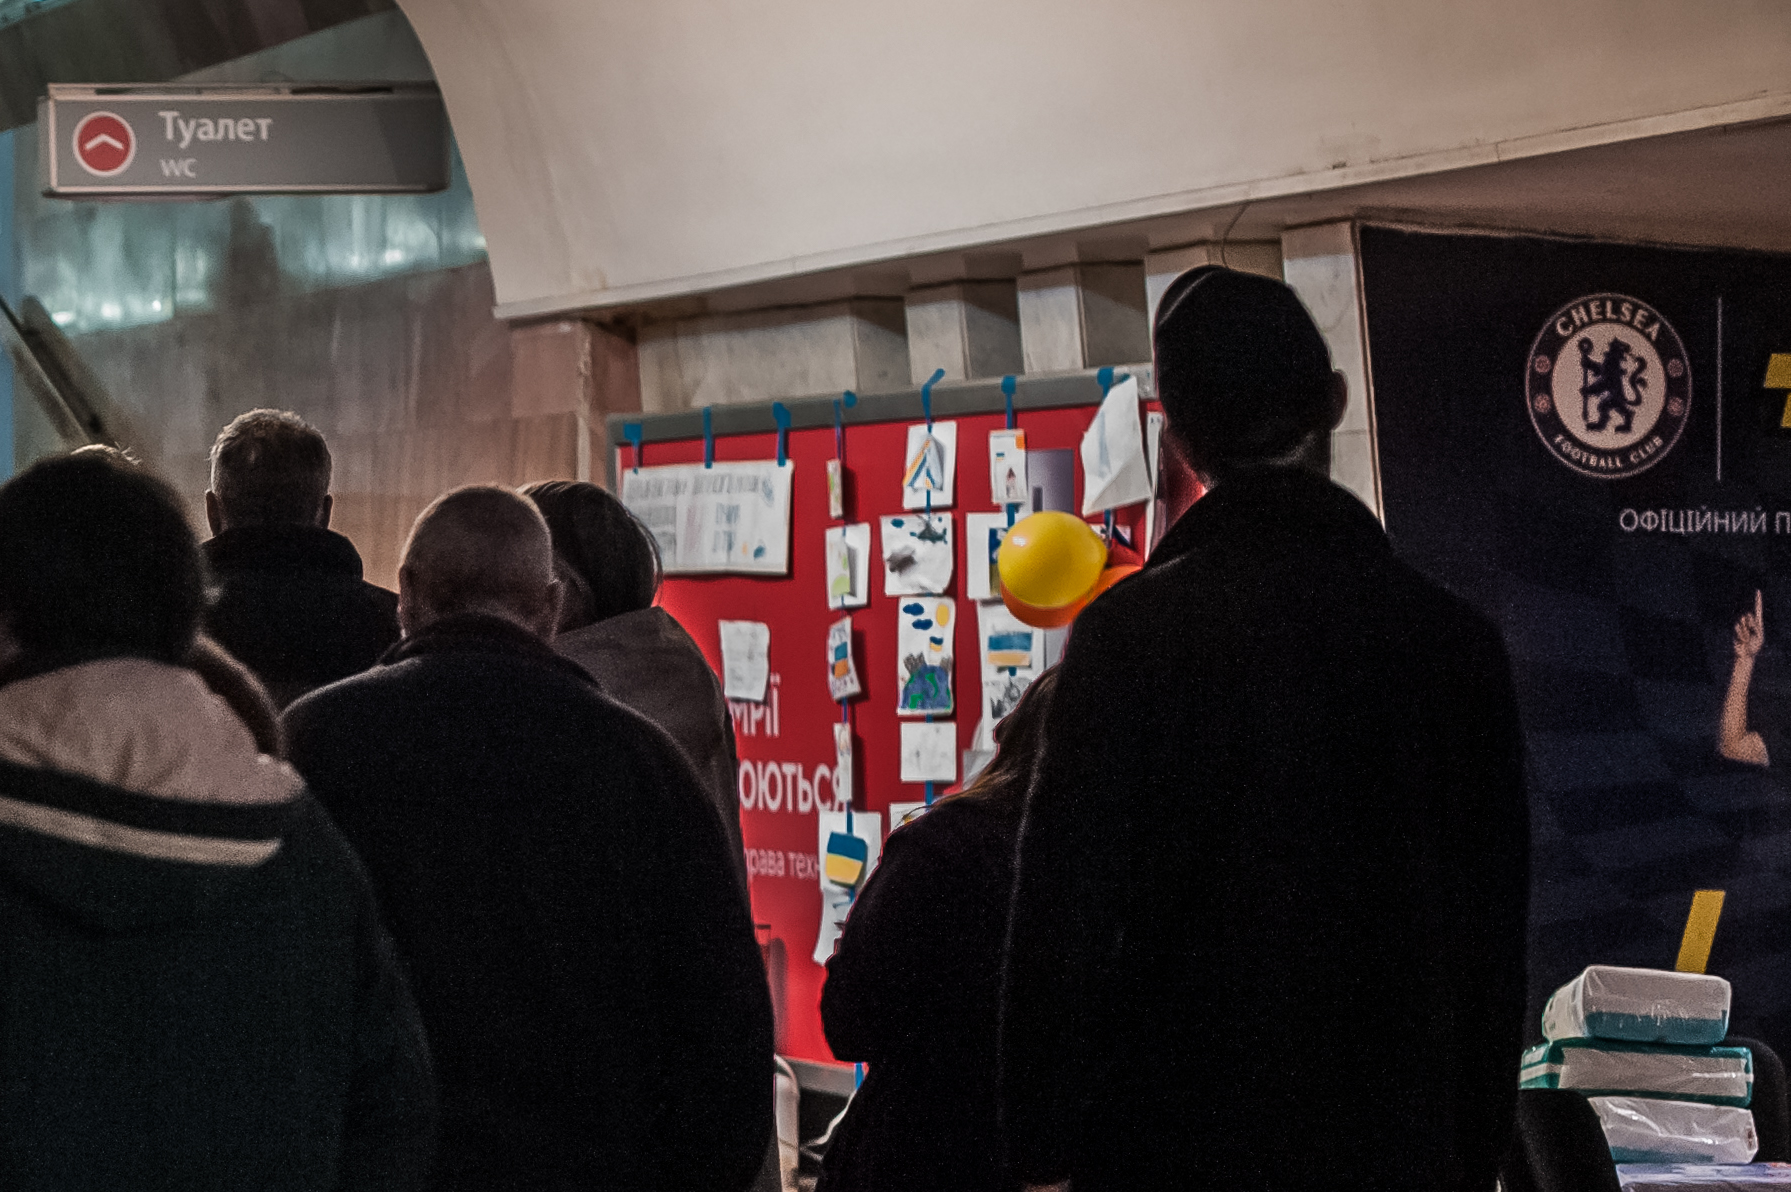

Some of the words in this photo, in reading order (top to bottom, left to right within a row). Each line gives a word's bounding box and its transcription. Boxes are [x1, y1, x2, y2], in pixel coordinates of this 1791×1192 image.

[158, 110, 272, 149] Туалет
[160, 158, 197, 178] WC
[1556, 300, 1660, 341] CHELSEA
[1554, 434, 1623, 469] FOOTBALL
[1630, 435, 1663, 464] CLUB
[1619, 505, 1767, 535] ОФІЦІЙНИЙ
